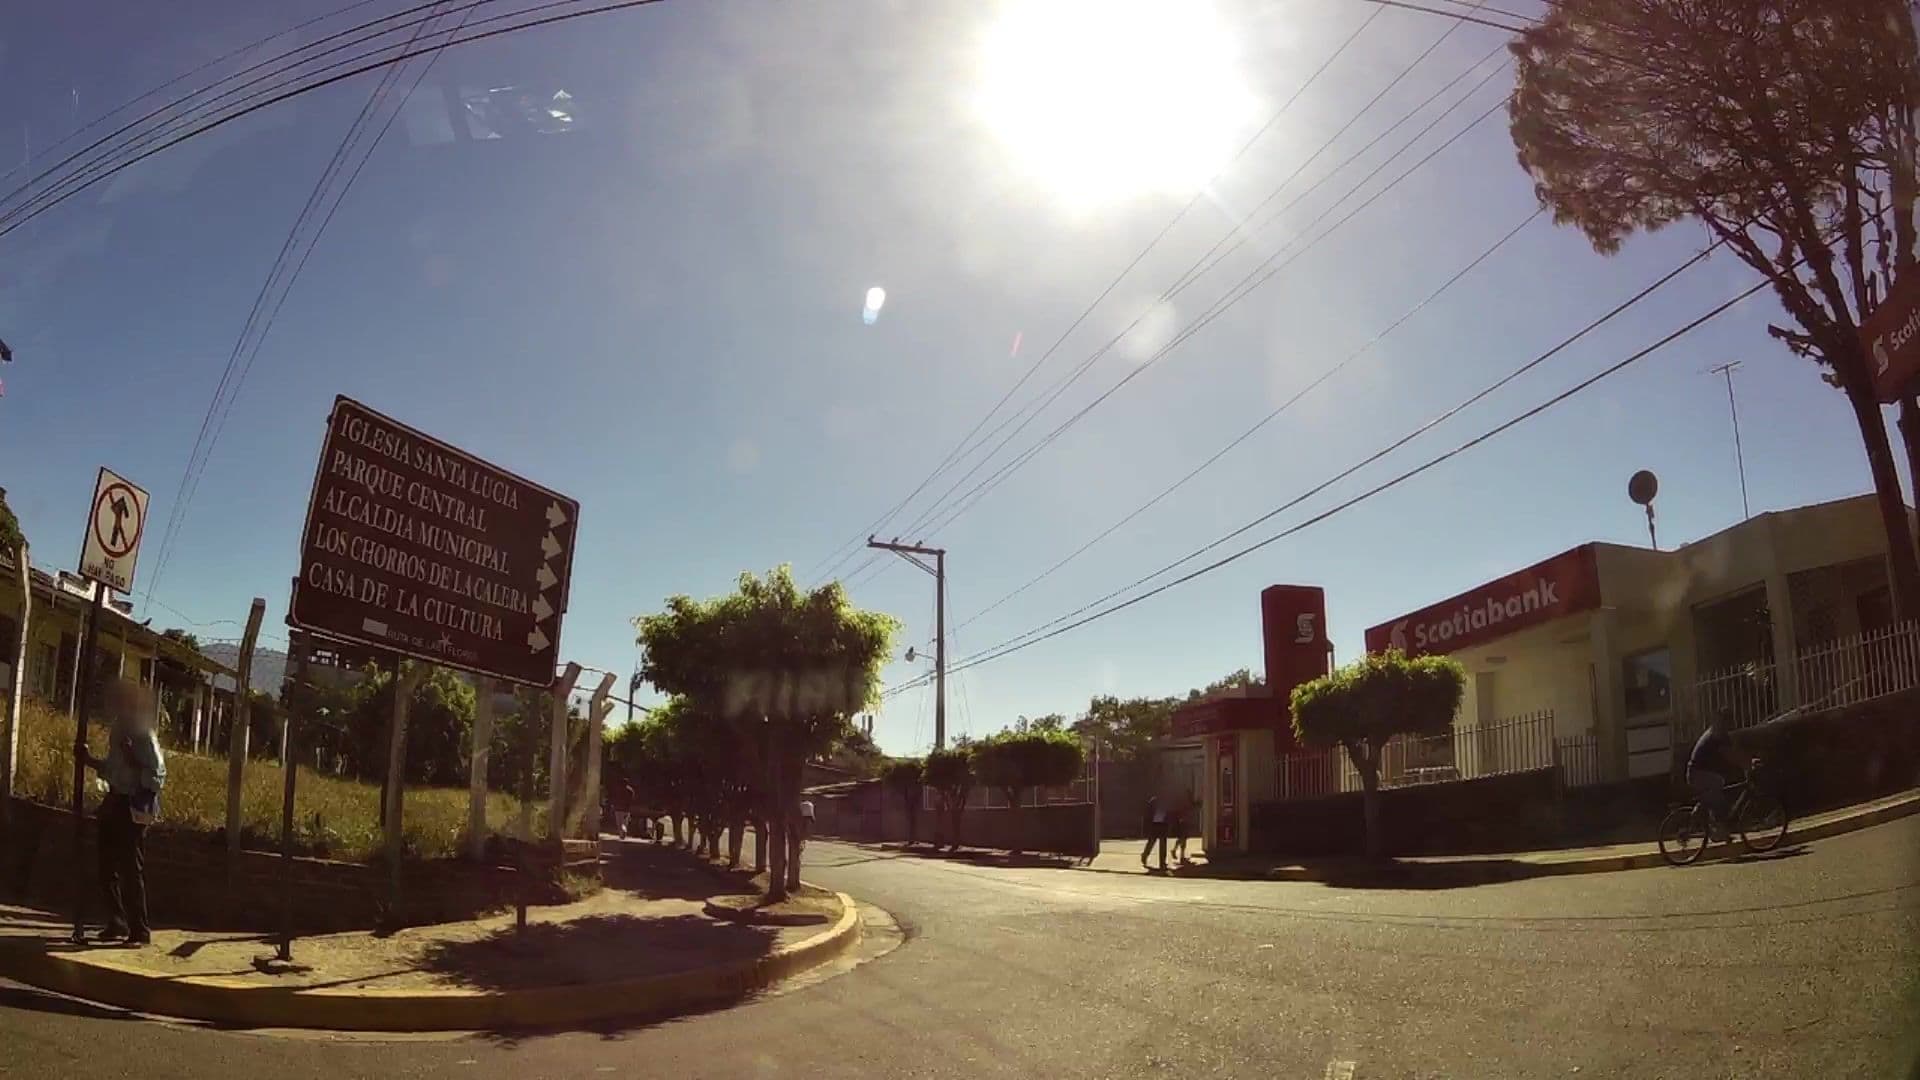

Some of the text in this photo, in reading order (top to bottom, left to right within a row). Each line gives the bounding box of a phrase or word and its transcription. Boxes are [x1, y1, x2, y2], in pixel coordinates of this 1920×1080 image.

[1890, 308, 1920, 351] Scoti
[331, 448, 487, 532] PARQUE CENTRAL
[340, 413, 519, 511] IGLESIA SANTA LUCIA
[314, 522, 348, 556] LOS
[351, 536, 425, 581] CHORROS
[428, 562, 452, 589] DE
[473, 577, 528, 614] CALERA
[322, 486, 510, 574] ALCALDIA MUNICIPAL
[309, 562, 503, 641] CASA DE LA CULTURA
[1415, 577, 1559, 649] Scotiabank
